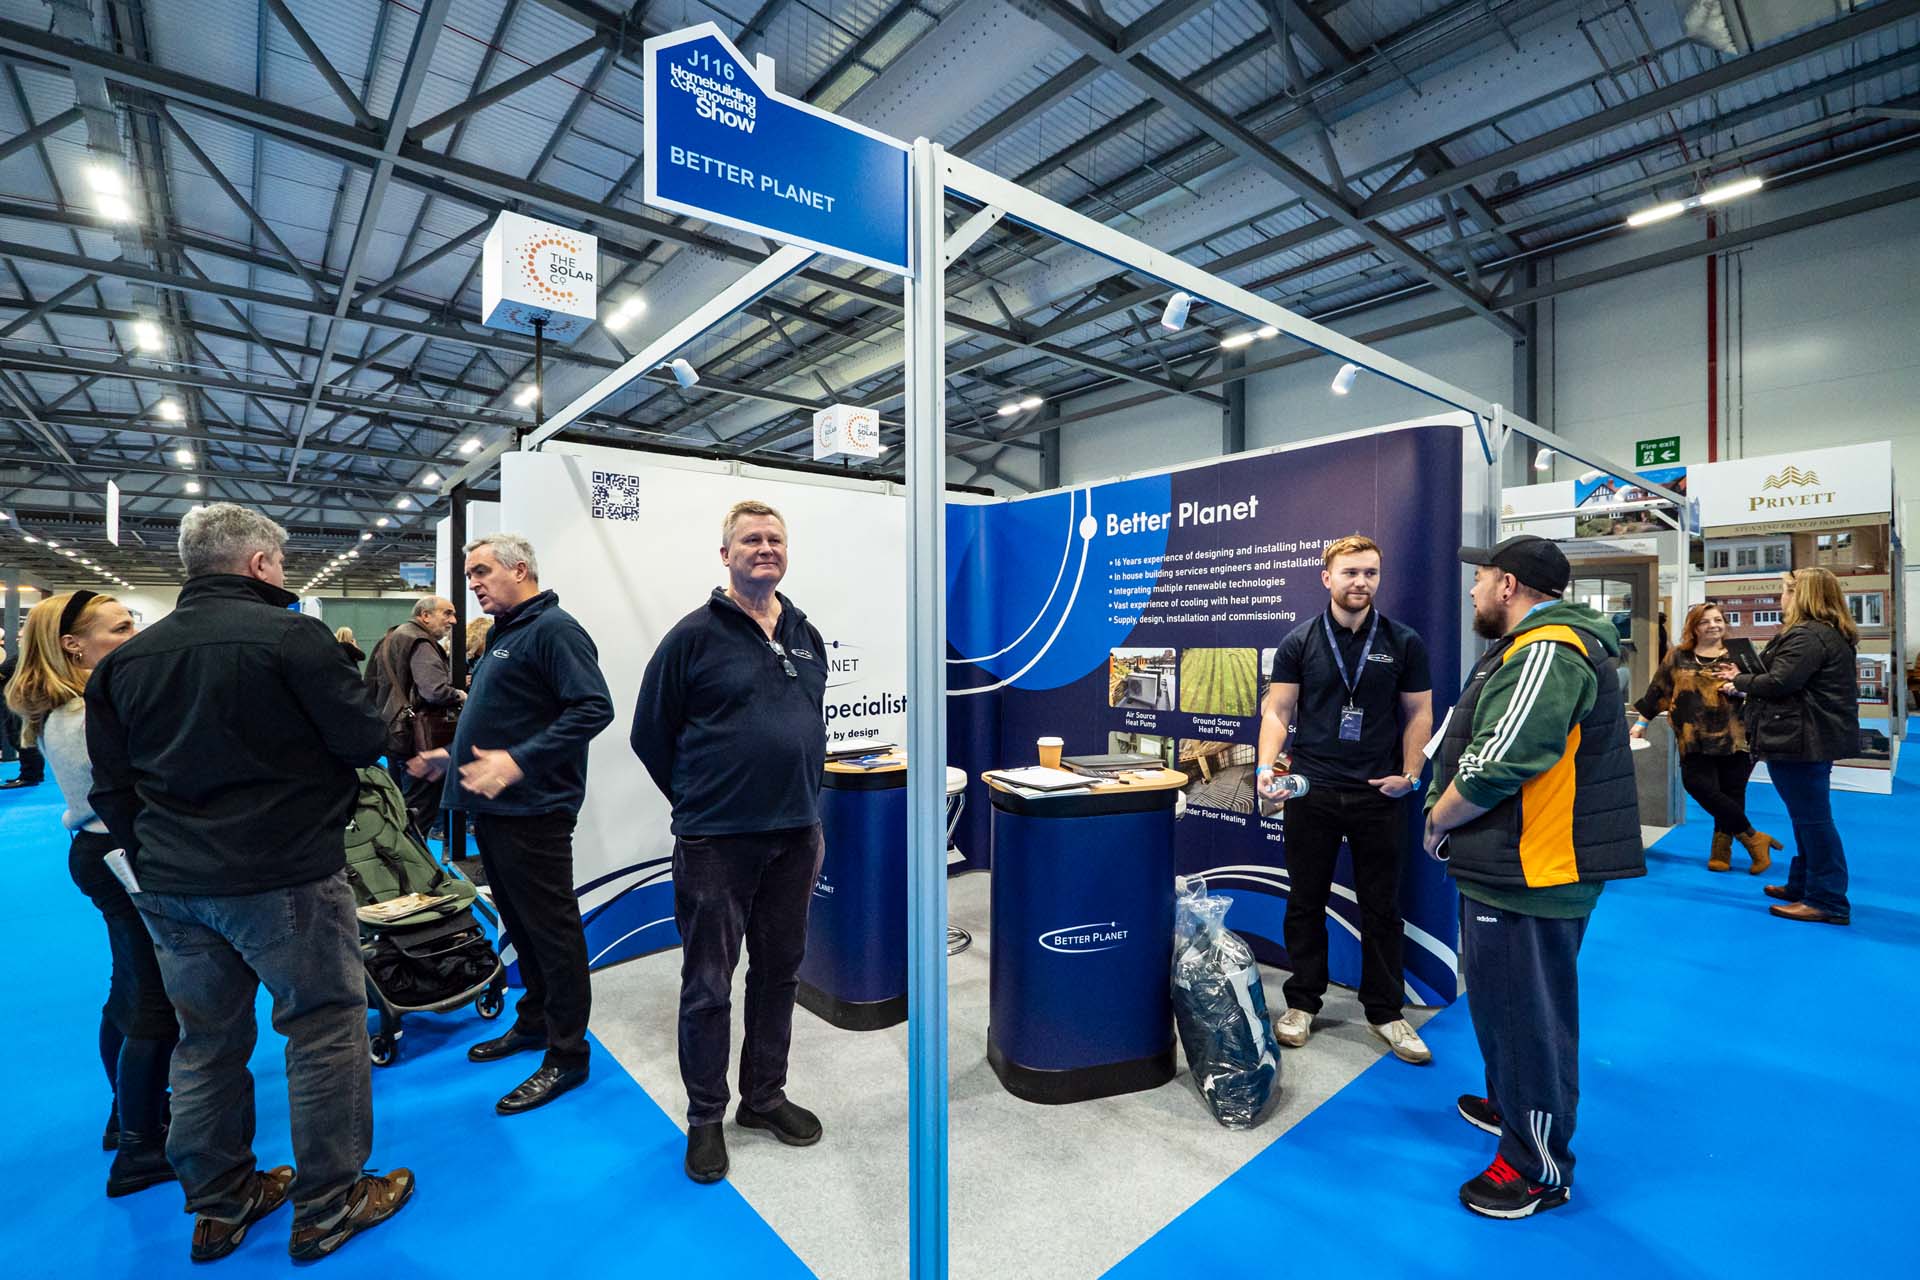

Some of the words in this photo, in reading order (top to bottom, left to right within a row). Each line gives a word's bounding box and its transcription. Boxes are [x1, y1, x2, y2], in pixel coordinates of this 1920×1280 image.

[687, 49, 735, 81] J116
[671, 62, 756, 108] Homebuilding
[696, 97, 756, 134] Show
[670, 145, 755, 188] BETTER
[760, 175, 836, 213] PLANET
[551, 253, 576, 268] THE
[550, 264, 593, 281] SOLAR
[1659, 440, 1675, 448] exit
[1748, 491, 1836, 512] PRIVETT
[1106, 511, 1171, 537] Better
[1178, 495, 1259, 528] Planet
[1114, 558, 1121, 567] 16
[1122, 558, 1142, 566] Years
[1143, 553, 1184, 565] experience
[1185, 552, 1193, 560] of
[1195, 547, 1234, 559] designing
[1236, 545, 1252, 555] and
[1254, 542, 1297, 552] installing
[1299, 539, 1321, 549] heat
[1323, 539, 1338, 549] pu
[1122, 572, 1143, 580] house
[1144, 569, 1173, 579] building
[1175, 567, 1208, 577] services
[1210, 563, 1252, 575] engineers
[1254, 560, 1271, 570] and
[1113, 585, 1151, 597] Integrating
[1152, 583, 1183, 594] multiple
[1185, 580, 1226, 591] renewable
[1229, 577, 1286, 589] technologies
[1113, 601, 1128, 609] Vast
[1130, 599, 1169, 610] experience
[1170, 598, 1178, 607] of
[1180, 597, 1208, 608] cooling
[1210, 595, 1228, 606] with
[1230, 595, 1249, 605] heat
[1251, 594, 1282, 606] pumps
[1113, 615, 1138, 625] Supply,
[1139, 614, 1165, 625] design,
[1166, 613, 1209, 623] installation
[1211, 612, 1227, 622] and
[1228, 610, 1296, 622] commissioning
[827, 659, 859, 672] NET
[825, 692, 907, 726] pecialist
[1135, 711, 1156, 720] Source
[1140, 719, 1157, 729] Pump
[1192, 716, 1216, 726] Ground
[1217, 717, 1240, 727] Source
[833, 731, 845, 741] by
[848, 728, 879, 738] design
[1198, 725, 1214, 734] Heat
[1215, 726, 1234, 736] Pump
[1185, 807, 1201, 816] nder
[1201, 809, 1219, 819] Floor
[1220, 813, 1246, 826] Heating
[1266, 832, 1281, 841] and
[1054, 936, 1090, 945] BETTER
[1093, 931, 1128, 942] PLANET
